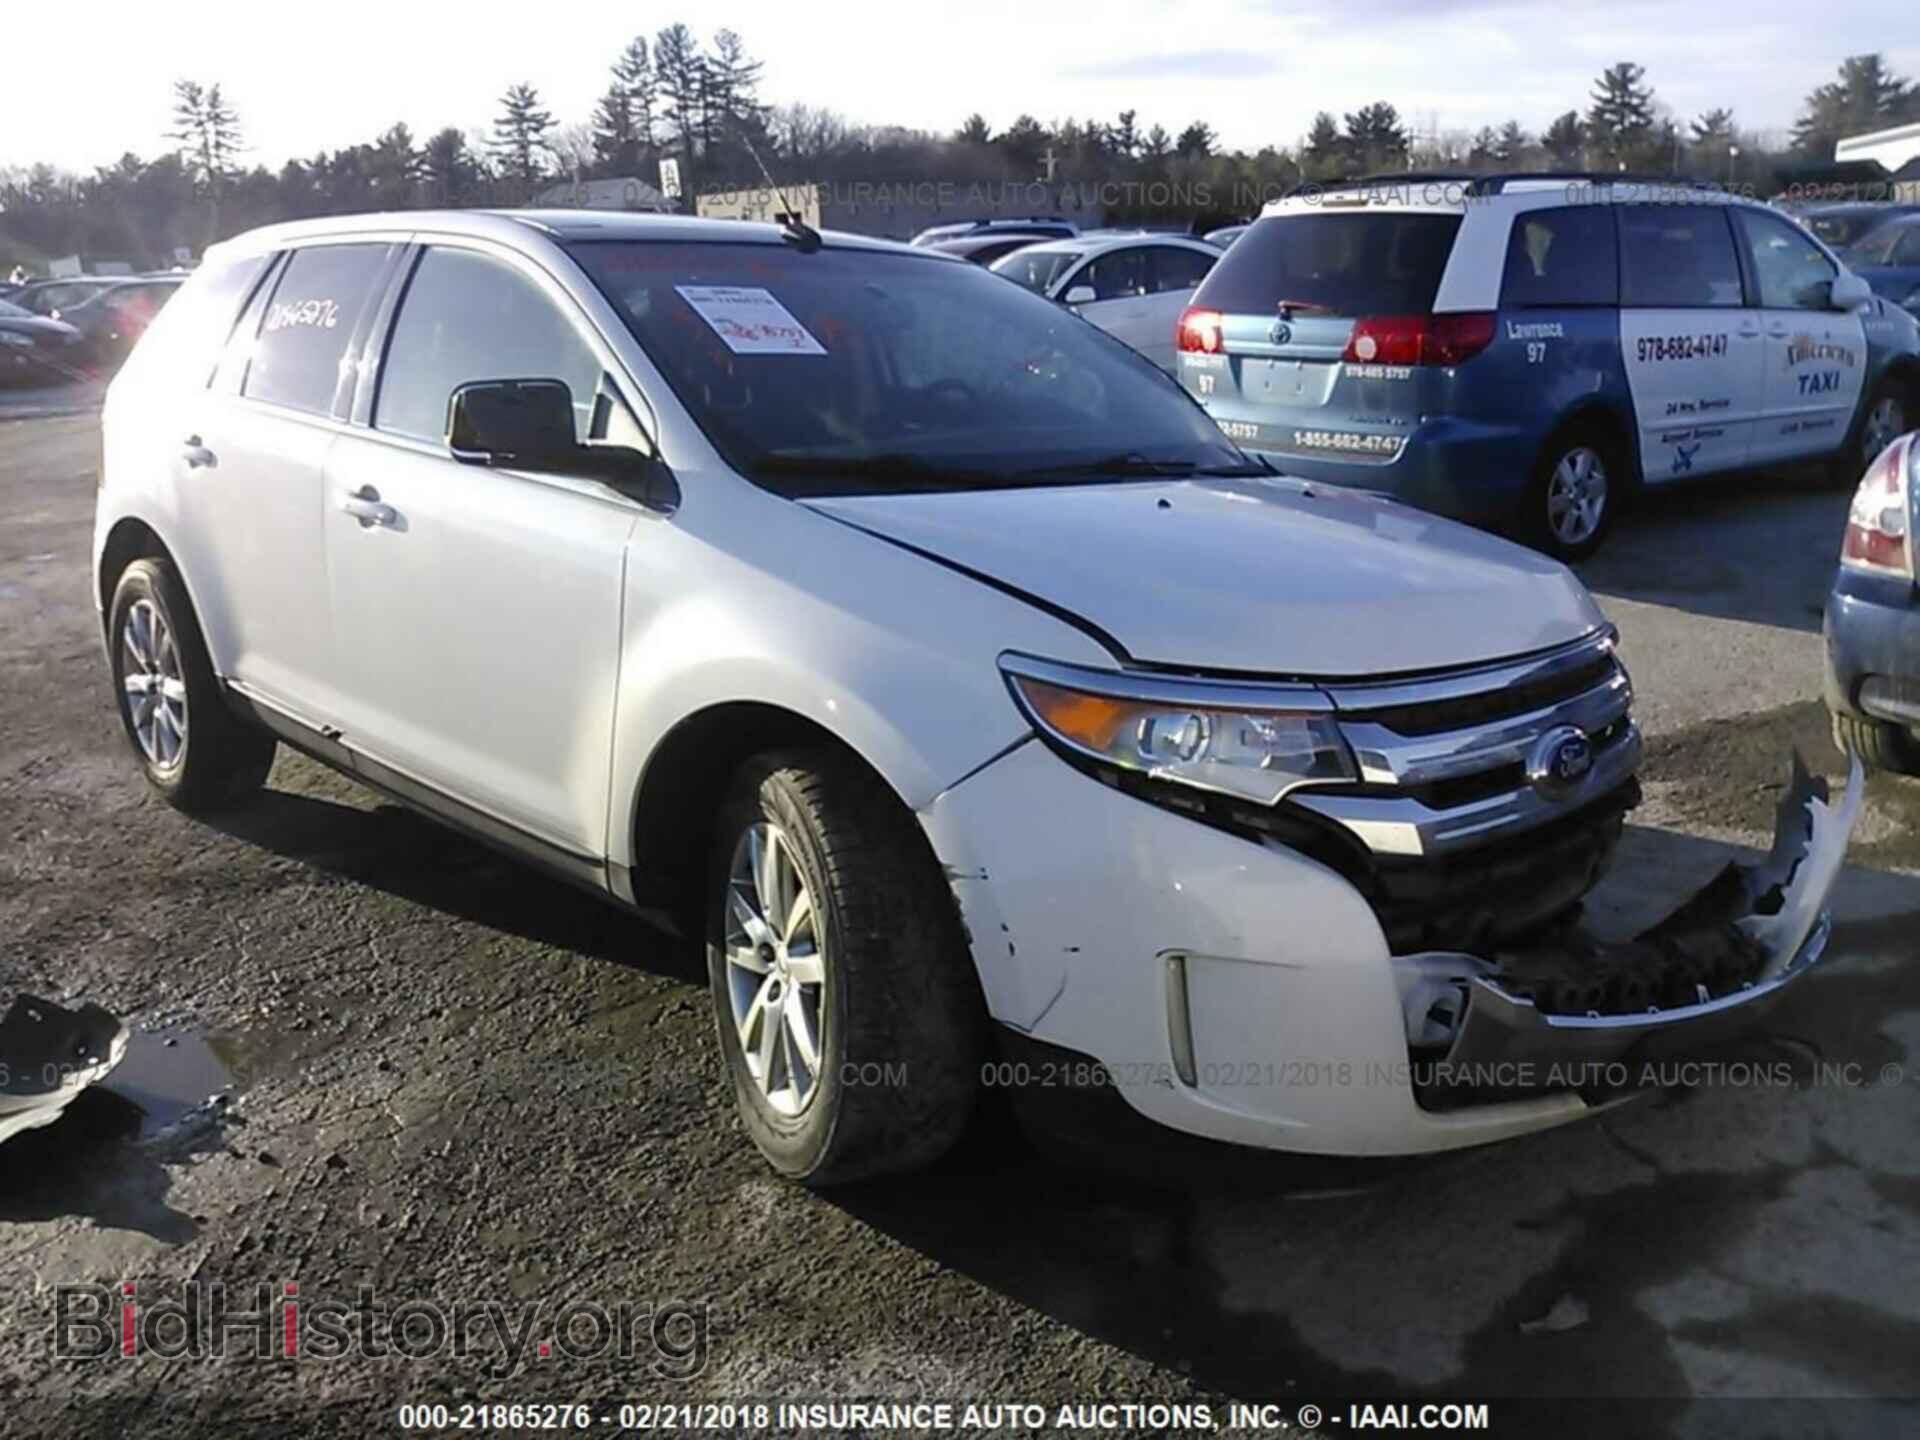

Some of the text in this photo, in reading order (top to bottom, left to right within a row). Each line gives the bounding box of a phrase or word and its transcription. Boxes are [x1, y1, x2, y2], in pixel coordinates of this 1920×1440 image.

[1527, 341, 1547, 363] 97
[1637, 333, 1728, 362] 978-682-4747
[1798, 370, 1841, 395] TAXI
